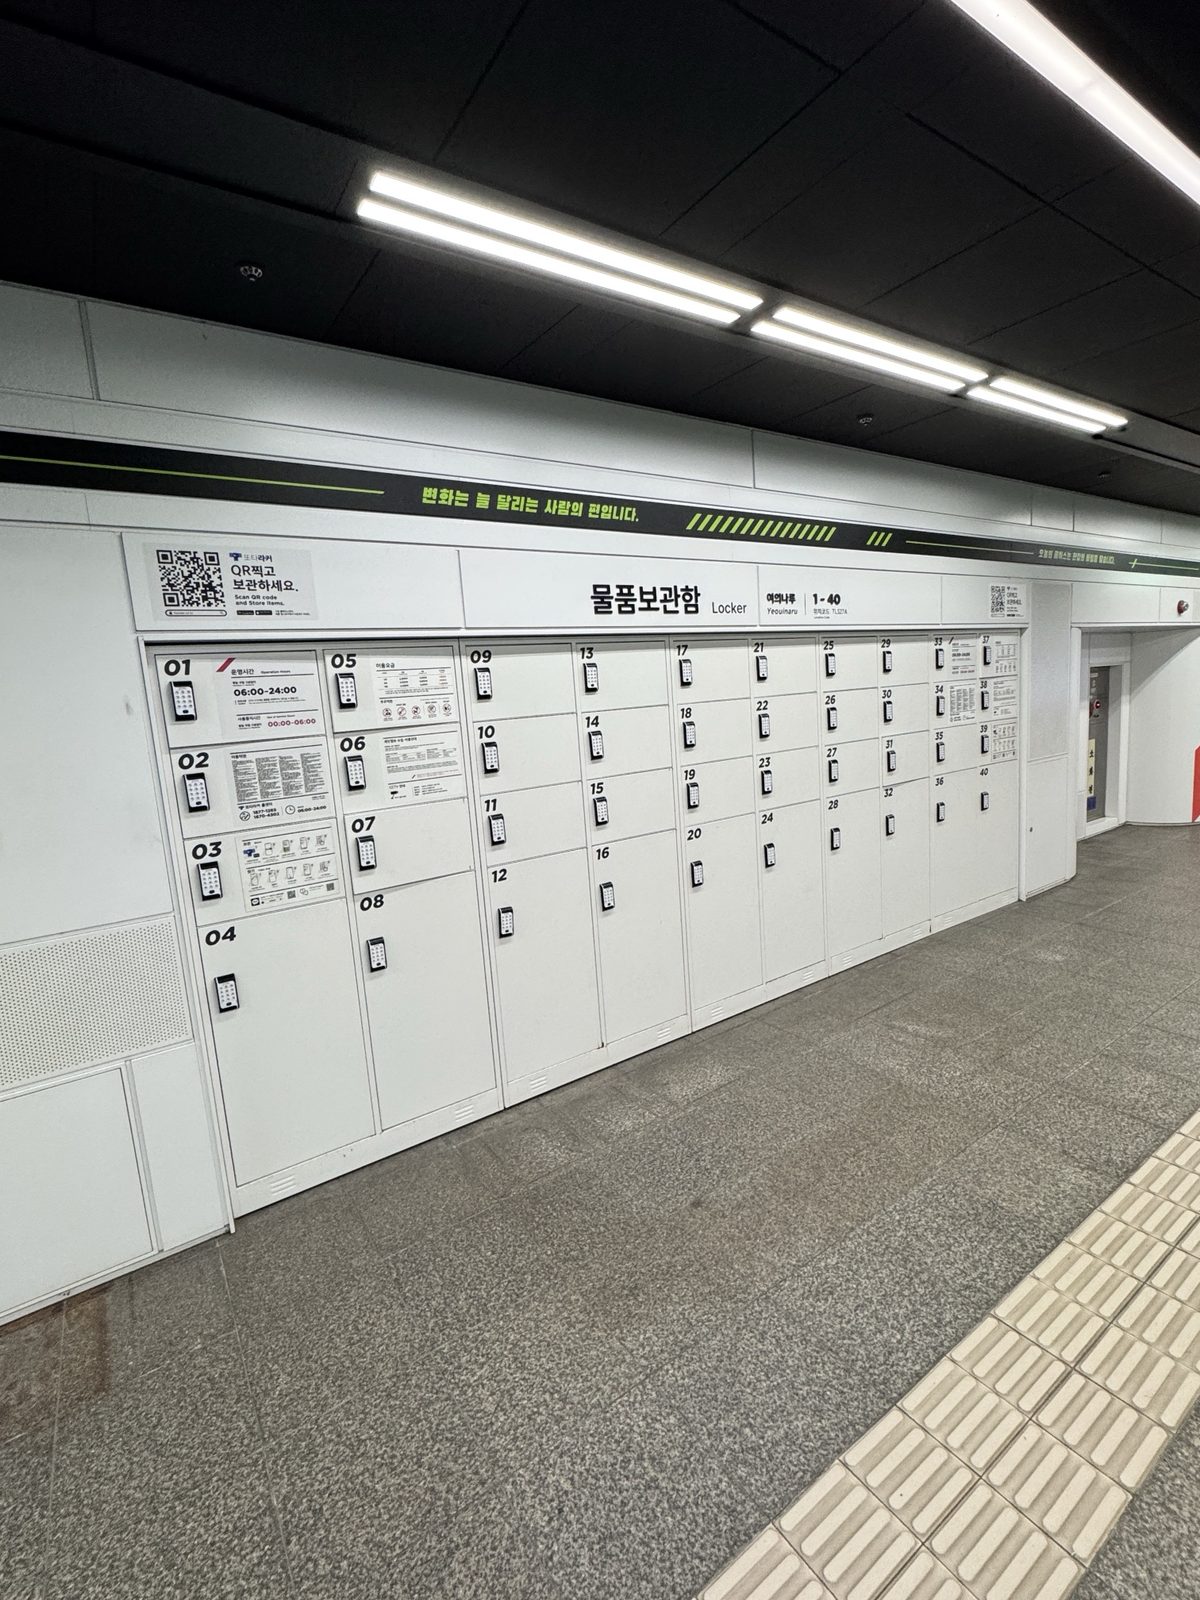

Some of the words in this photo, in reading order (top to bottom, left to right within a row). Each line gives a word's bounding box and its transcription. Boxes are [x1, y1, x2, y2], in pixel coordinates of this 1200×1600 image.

[422, 486, 469, 508] 변화는
[475, 492, 490, 509] 늘
[496, 494, 538, 513] 달리는
[544, 498, 584, 517] 사람의
[588, 503, 639, 522] 편입니다.
[231, 564, 276, 577] QR찍고
[233, 579, 299, 592] 보관하세요.
[590, 584, 700, 615] 물품보관함
[766, 593, 796, 604] 여의나루
[712, 602, 746, 614] Locker
[754, 643, 764, 652] 21
[824, 640, 834, 650] 25
[881, 639, 890, 648] 29
[580, 648, 593, 659] 13
[676, 644, 688, 656] 17
[330, 654, 356, 668] 05
[471, 650, 491, 663] 09
[164, 658, 190, 676] 01
[233, 686, 297, 696] 06:00-24:00
[882, 690, 892, 698] 30
[934, 686, 944, 694] 34
[824, 694, 836, 704] 26
[756, 700, 768, 712] 22
[680, 708, 692, 718] 18
[268, 718, 316, 727] 00:00-06:00
[586, 716, 600, 728] 14
[478, 726, 494, 740] 10
[980, 724, 988, 734] 39
[936, 732, 944, 740] 35
[340, 736, 365, 752] 06
[886, 740, 892, 748] 31
[826, 748, 838, 758] 27
[178, 752, 209, 769] 02
[758, 756, 770, 768] 23
[684, 768, 696, 780] 19
[980, 768, 988, 776] 40
[936, 776, 944, 786] 36
[590, 782, 604, 794] 15
[884, 788, 894, 798] 32
[484, 798, 496, 812] 11
[828, 800, 838, 810] 28
[762, 812, 774, 824] 24
[352, 816, 376, 834] 07
[686, 828, 702, 840] 20
[192, 842, 222, 860] 03
[596, 846, 610, 860] 16
[492, 868, 506, 882] 12
[360, 894, 384, 912] 08
[206, 926, 236, 946] 04
